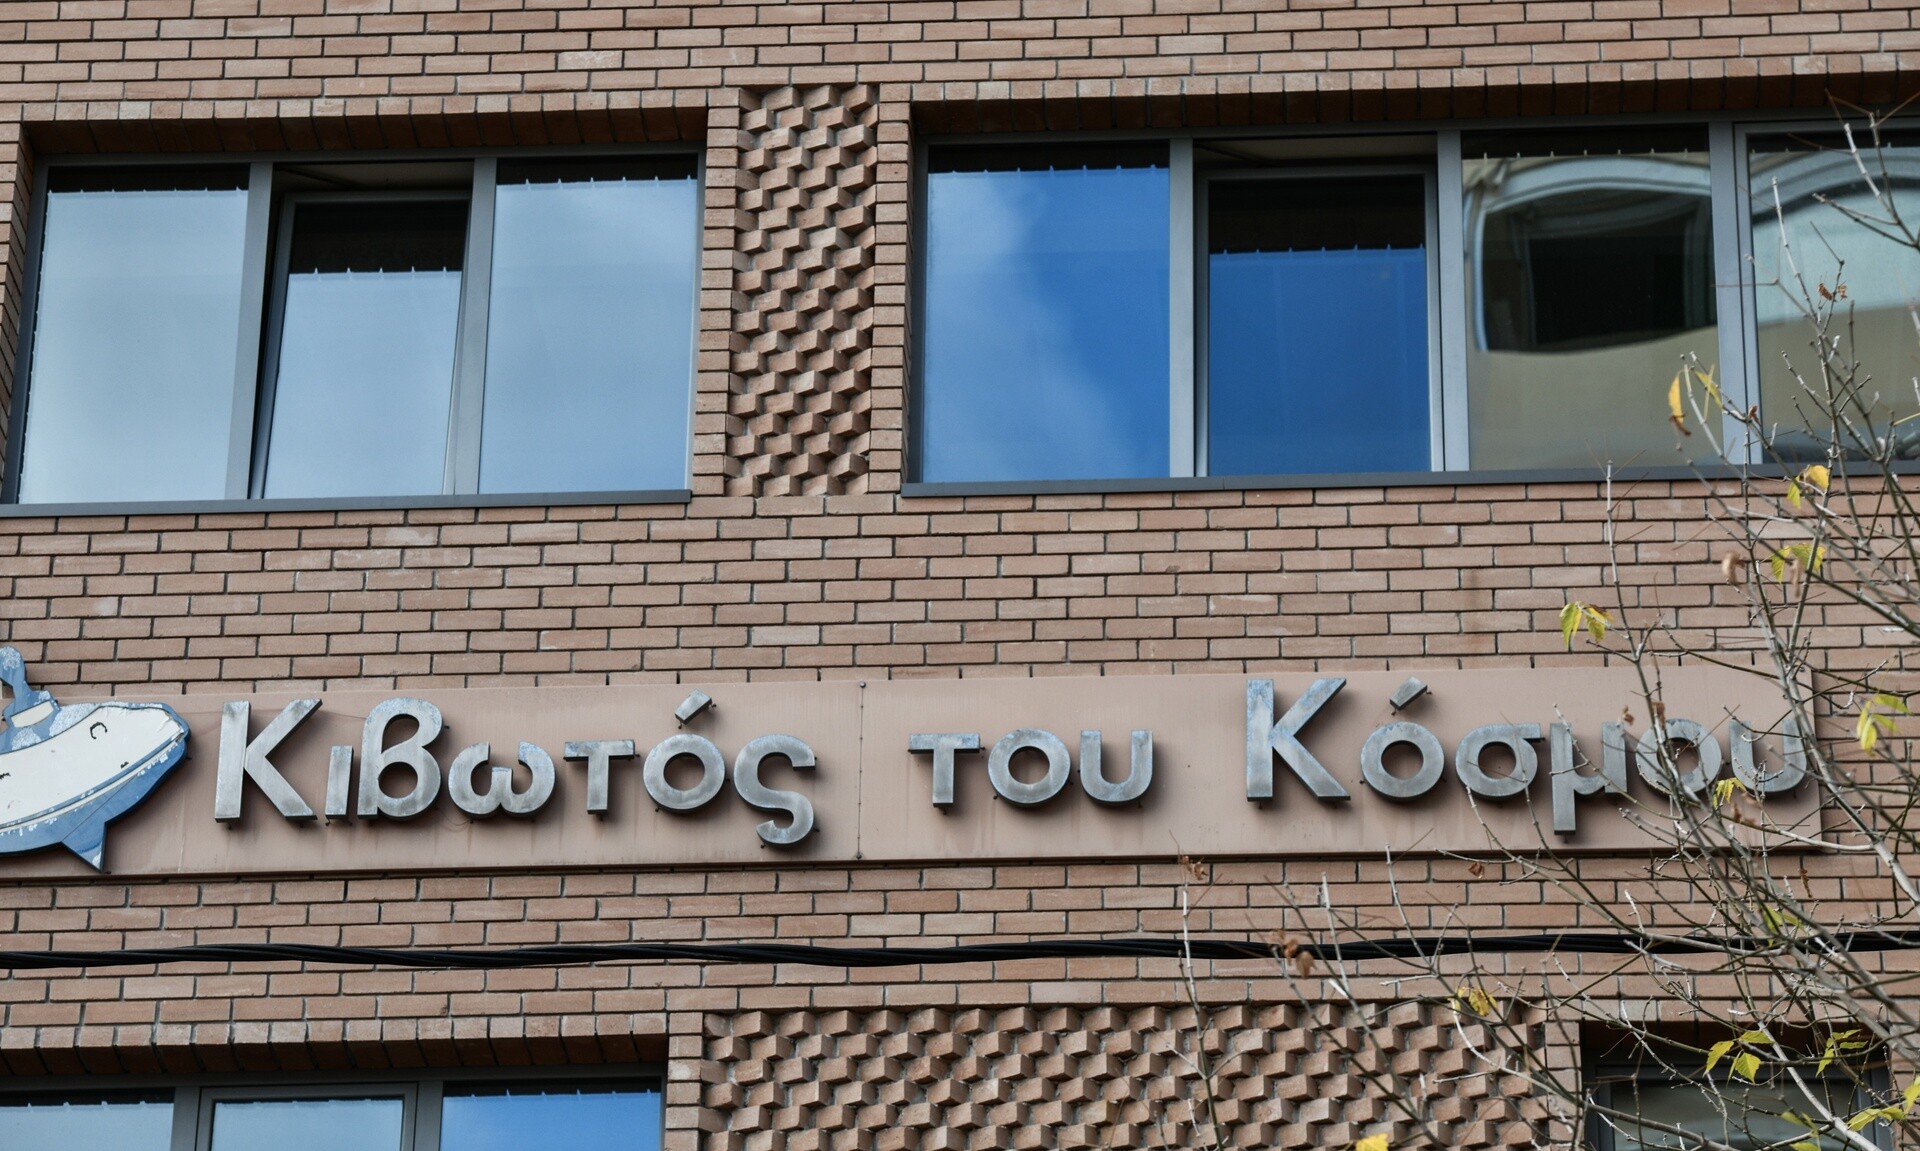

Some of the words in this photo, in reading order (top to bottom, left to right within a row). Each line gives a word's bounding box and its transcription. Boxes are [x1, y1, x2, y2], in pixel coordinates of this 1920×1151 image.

[214, 688, 816, 846] Κιβωτός
[909, 728, 1154, 808] του
[1245, 676, 1808, 835] Κόσμου
